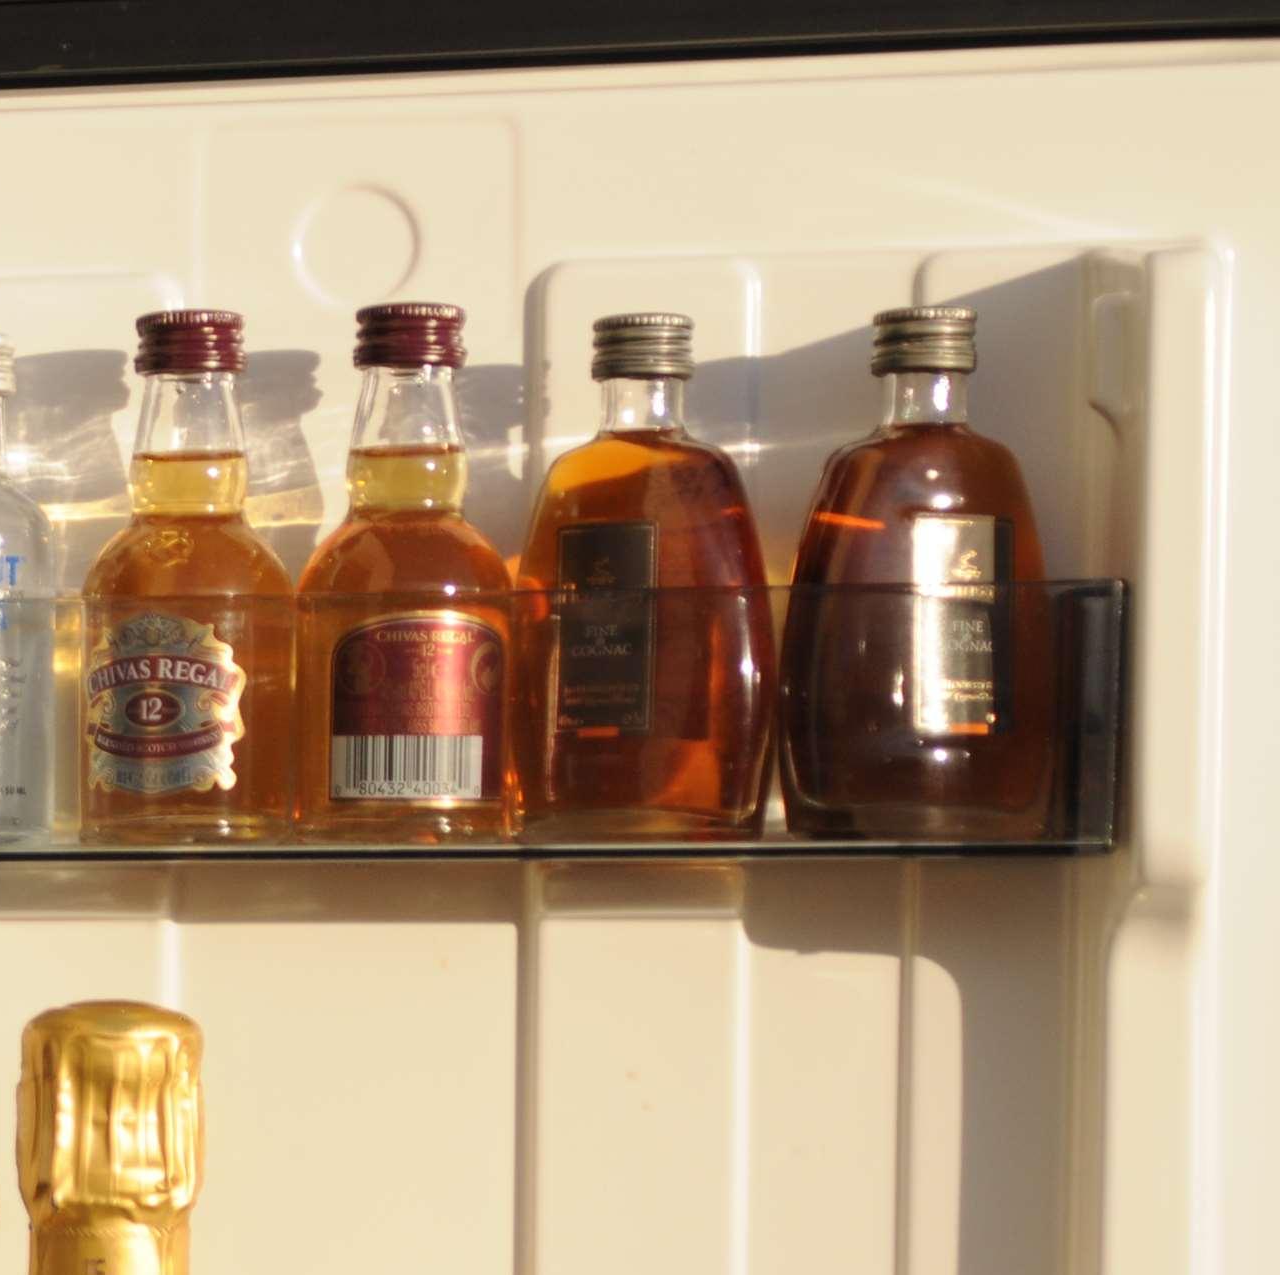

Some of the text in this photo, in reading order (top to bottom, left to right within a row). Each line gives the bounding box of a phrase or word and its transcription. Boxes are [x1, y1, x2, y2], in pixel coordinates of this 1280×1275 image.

[952, 619, 985, 632] FINE
[376, 630, 475, 643] CHIVAS REGAL
[421, 644, 437, 657] 12
[89, 658, 151, 694] CHIVAS
[140, 696, 163, 721] 12
